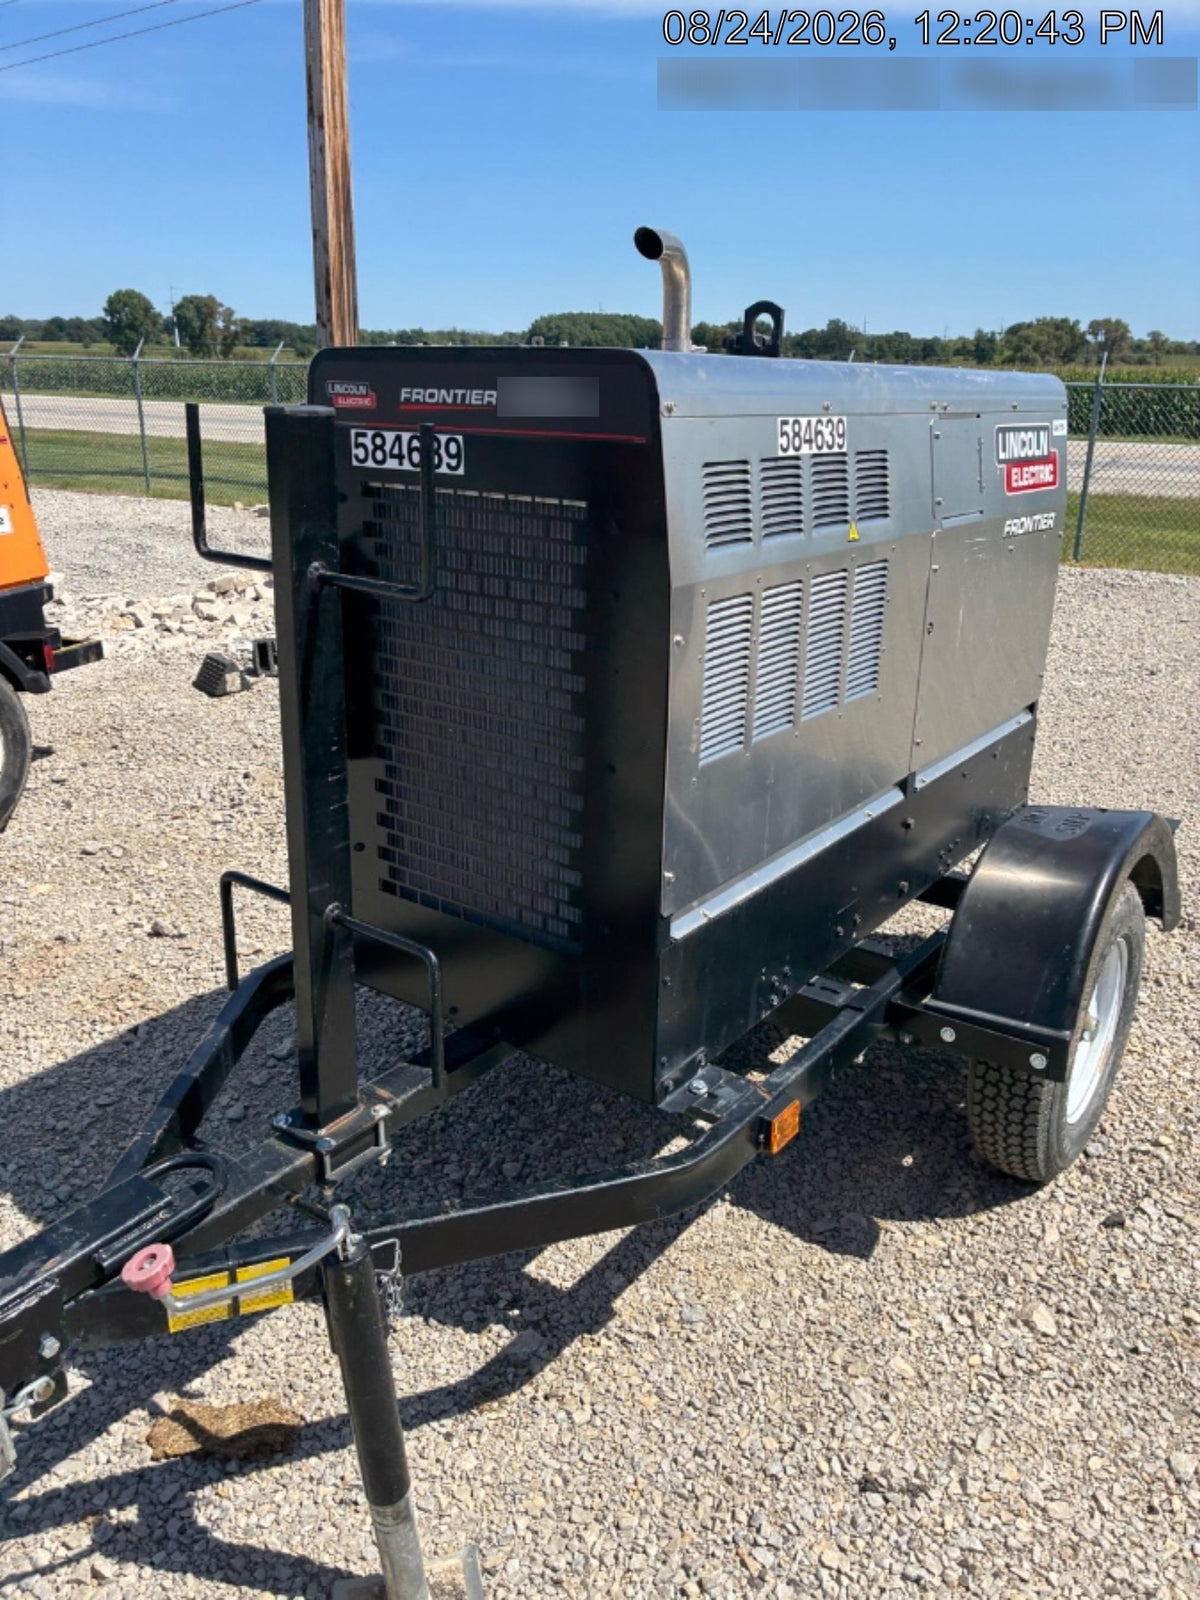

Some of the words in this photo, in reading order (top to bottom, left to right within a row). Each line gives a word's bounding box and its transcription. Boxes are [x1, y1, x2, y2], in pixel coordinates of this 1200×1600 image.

[328, 383, 366, 396] LINCOLN
[400, 387, 498, 406] FRONTIER
[779, 417, 846, 453] 584639
[998, 430, 1049, 459] LINCOLN
[1011, 463, 1054, 488] ELECTRIC
[1003, 512, 1056, 539] FRONTIER
